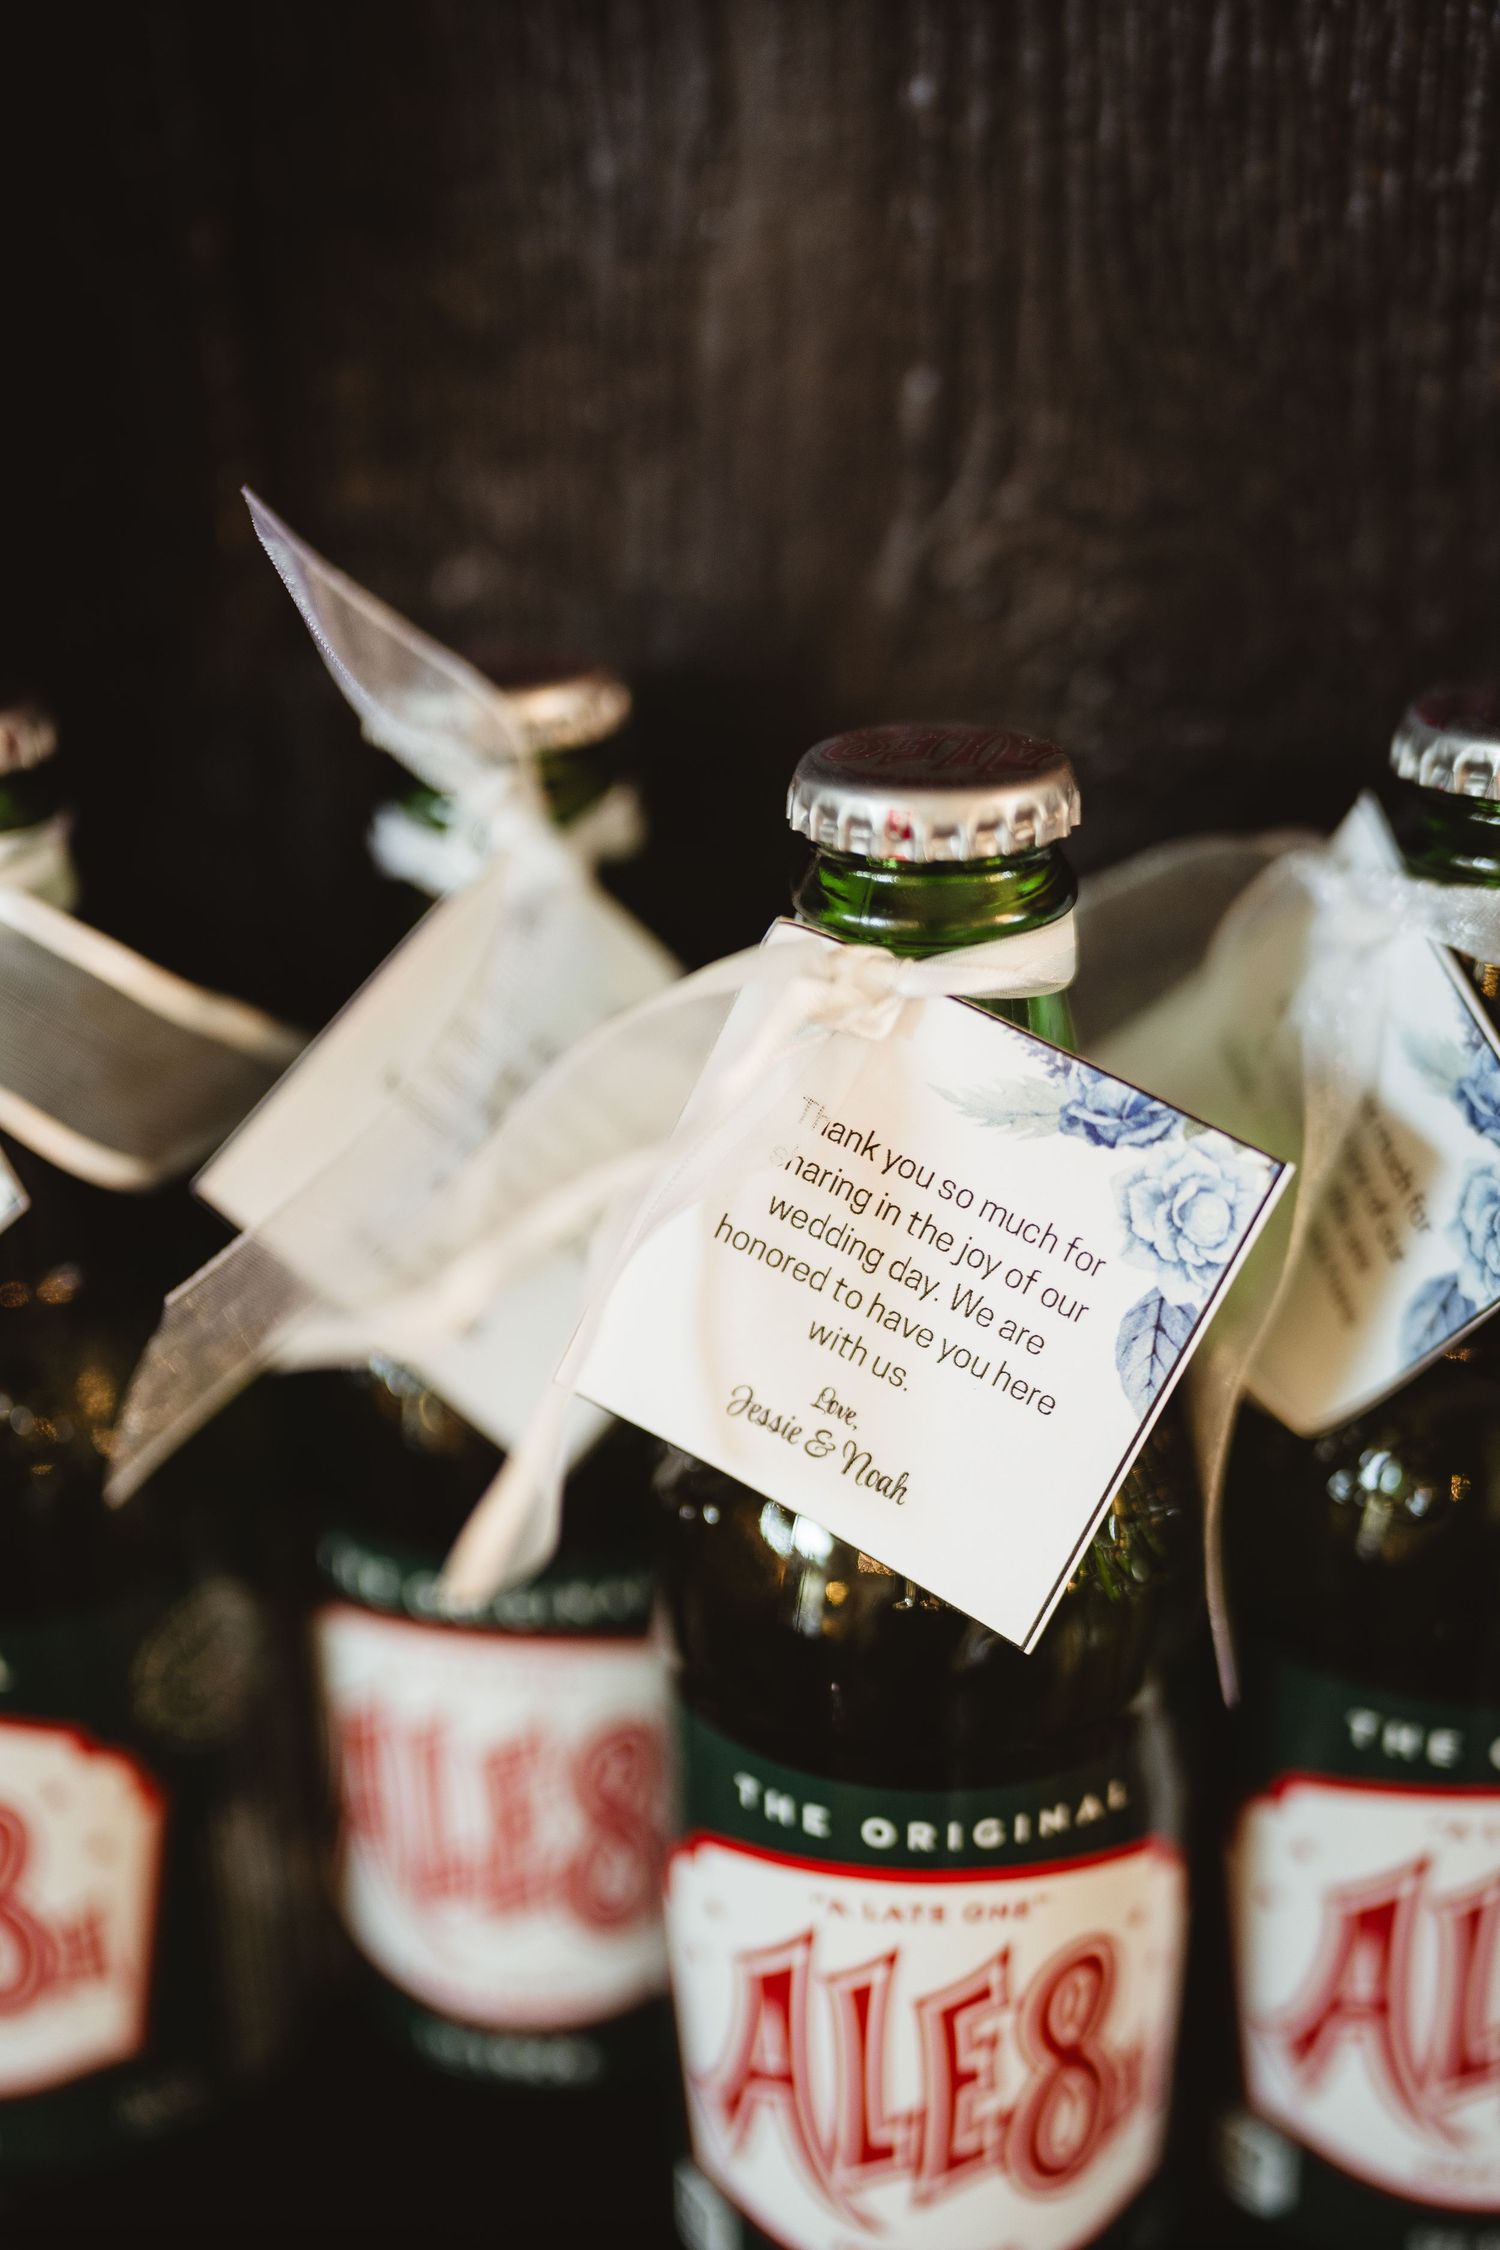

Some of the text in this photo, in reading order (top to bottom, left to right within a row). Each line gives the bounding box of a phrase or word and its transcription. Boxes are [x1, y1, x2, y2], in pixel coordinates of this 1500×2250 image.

[768, 1144, 1090, 1323] sharing in the joy of our
[799, 1096, 1107, 1277] Thank you so much for
[713, 1213, 1057, 1416] honored to have you here
[768, 1195, 1045, 1356] wedding day. We are
[808, 1320, 909, 1392] with us.
[810, 1386, 858, 1431] Love,
[726, 1384, 910, 1506] Jessie & Noah
[733, 1769, 1131, 1853] THE ORIGINAL
